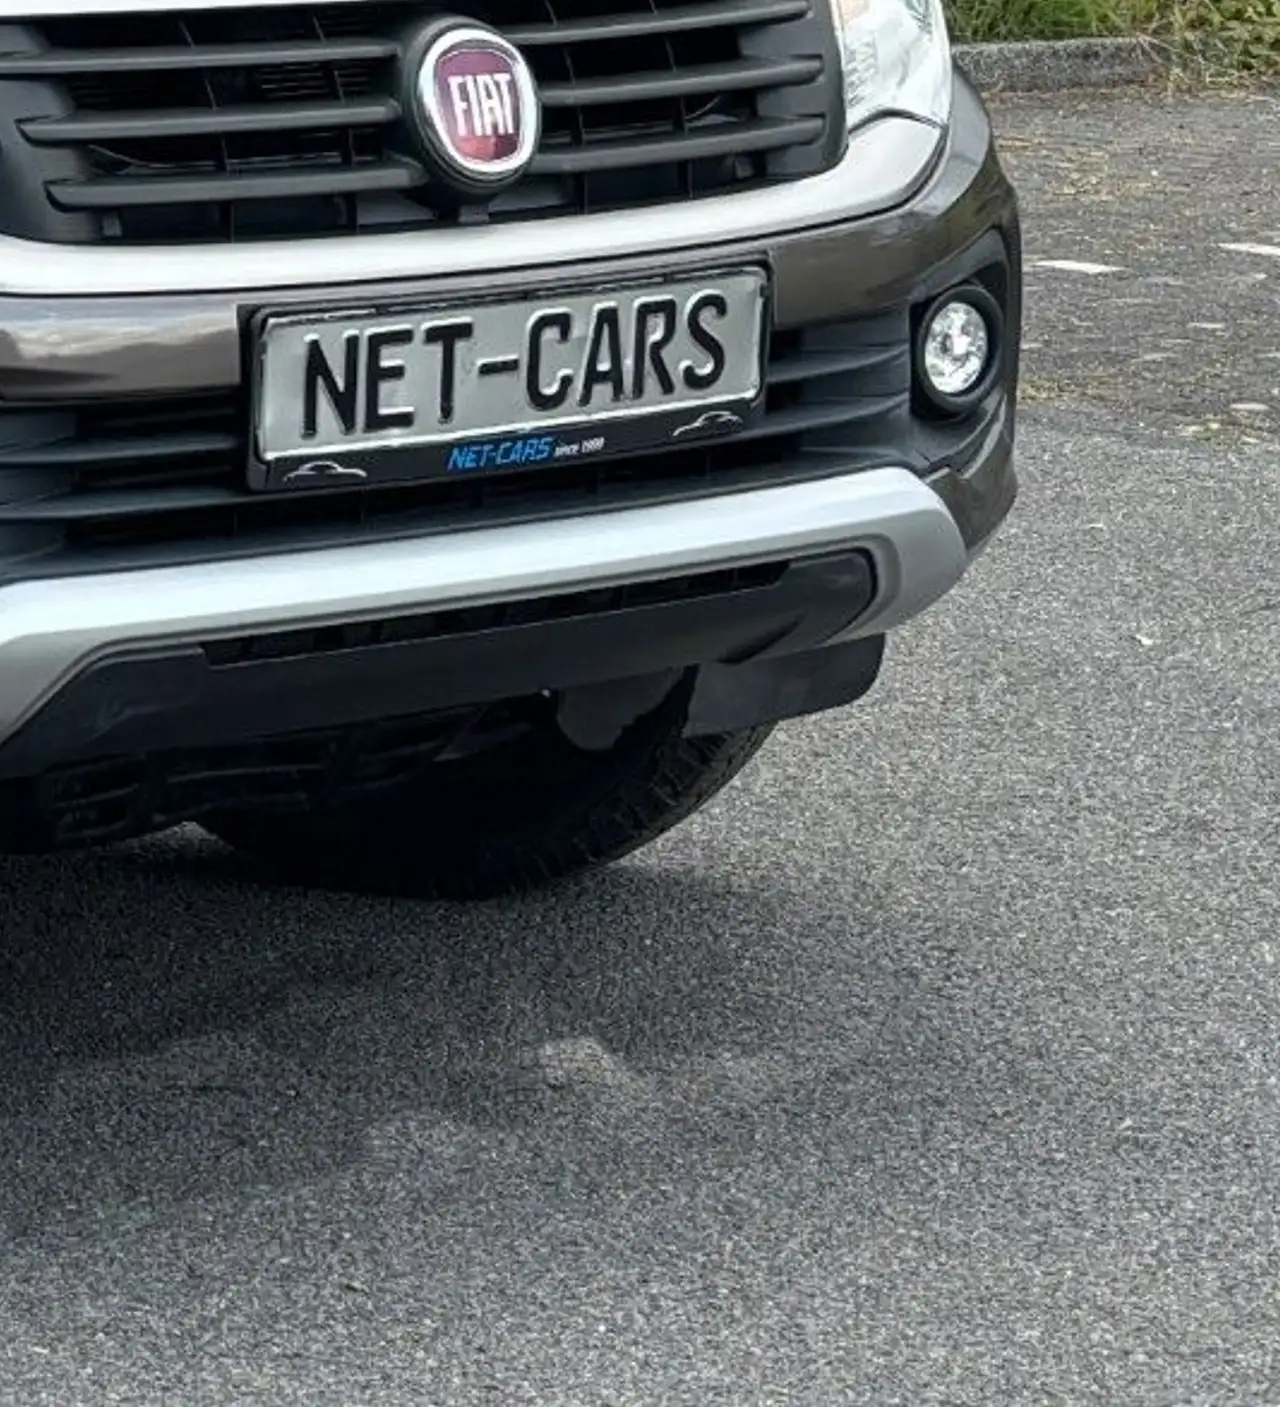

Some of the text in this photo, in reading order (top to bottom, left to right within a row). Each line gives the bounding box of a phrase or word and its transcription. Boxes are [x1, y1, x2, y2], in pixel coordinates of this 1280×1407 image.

[447, 73, 514, 137] FIAT
[300, 290, 727, 439] NET-CARS
[447, 436, 553, 470] NET-CARS
